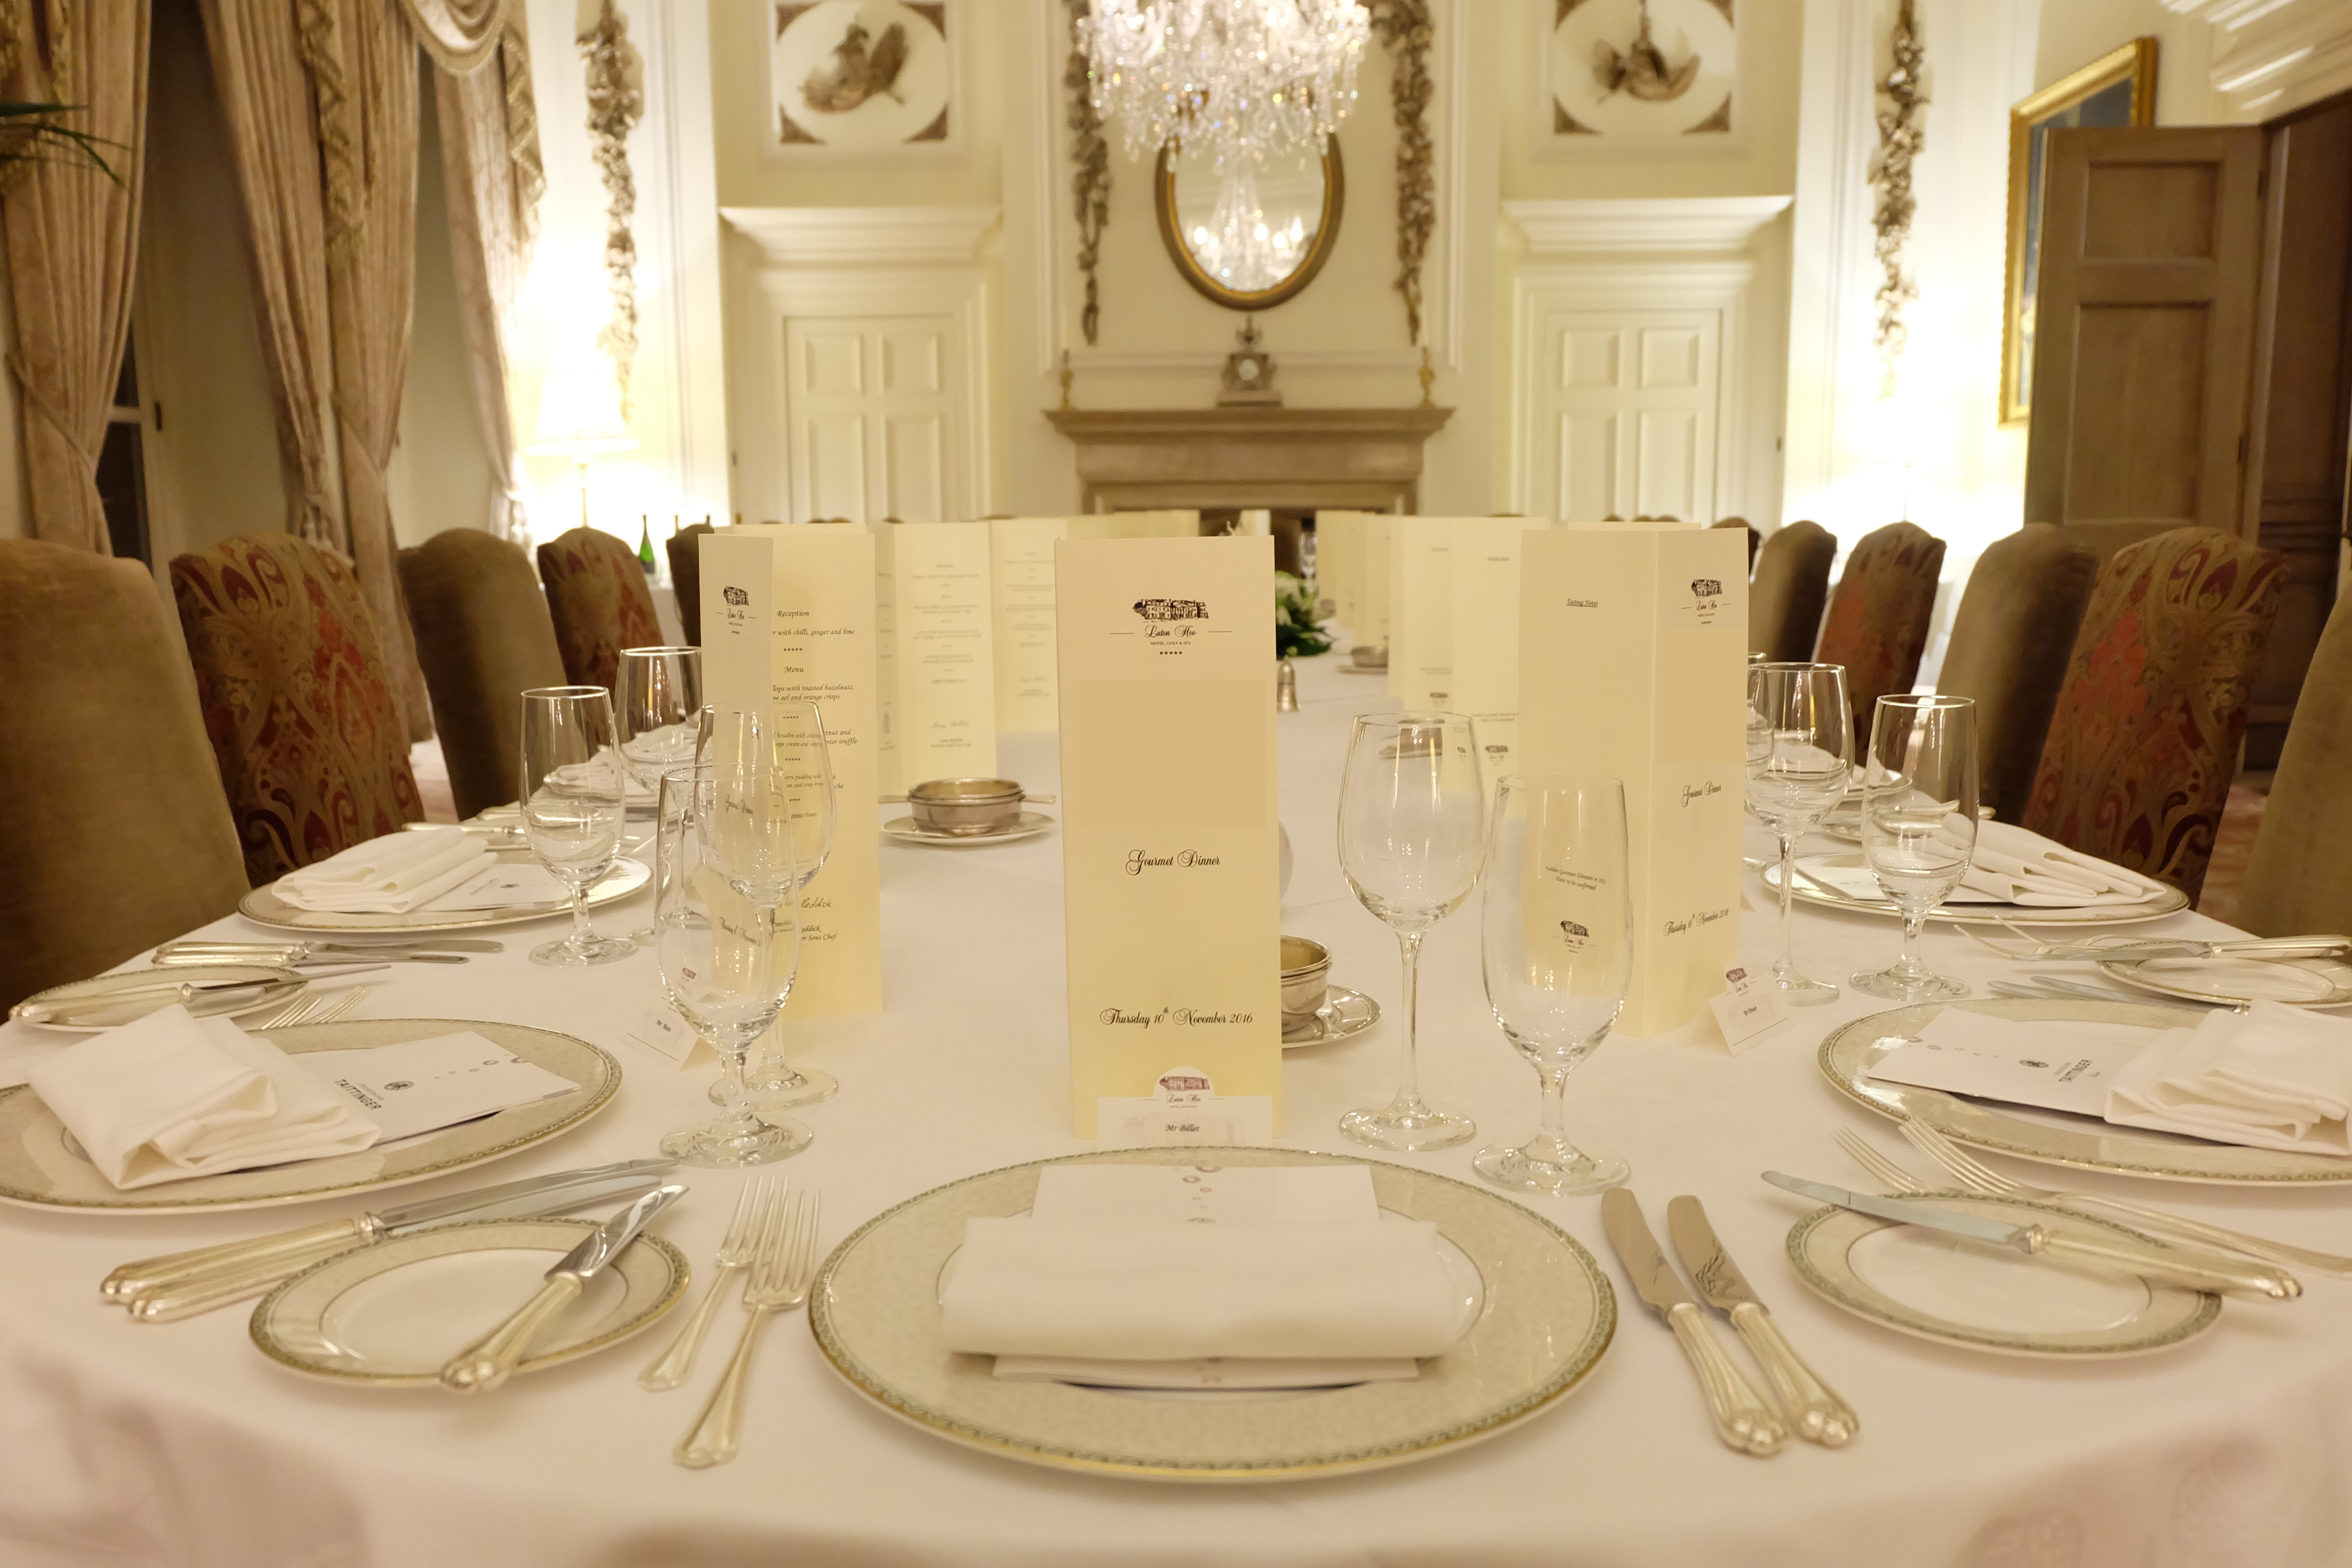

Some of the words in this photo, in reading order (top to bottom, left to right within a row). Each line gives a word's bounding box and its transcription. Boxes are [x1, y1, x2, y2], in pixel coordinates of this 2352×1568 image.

[776, 610, 809, 618] Reception
[1145, 625, 1171, 638] Luton
[1174, 625, 1197, 637] Hoo
[823, 694, 840, 702] crisps
[838, 737, 858, 746] truffle
[1126, 849, 1174, 876] Gourmet
[1177, 849, 1221, 868] Dinner
[823, 933, 838, 941] Chef
[1100, 1008, 1151, 1029] Thursday
[1173, 1008, 1226, 1027] November
[1228, 1012, 1253, 1024] 2016
[1165, 1124, 1177, 1132] Mr
[1179, 1124, 1200, 1132] Billet
